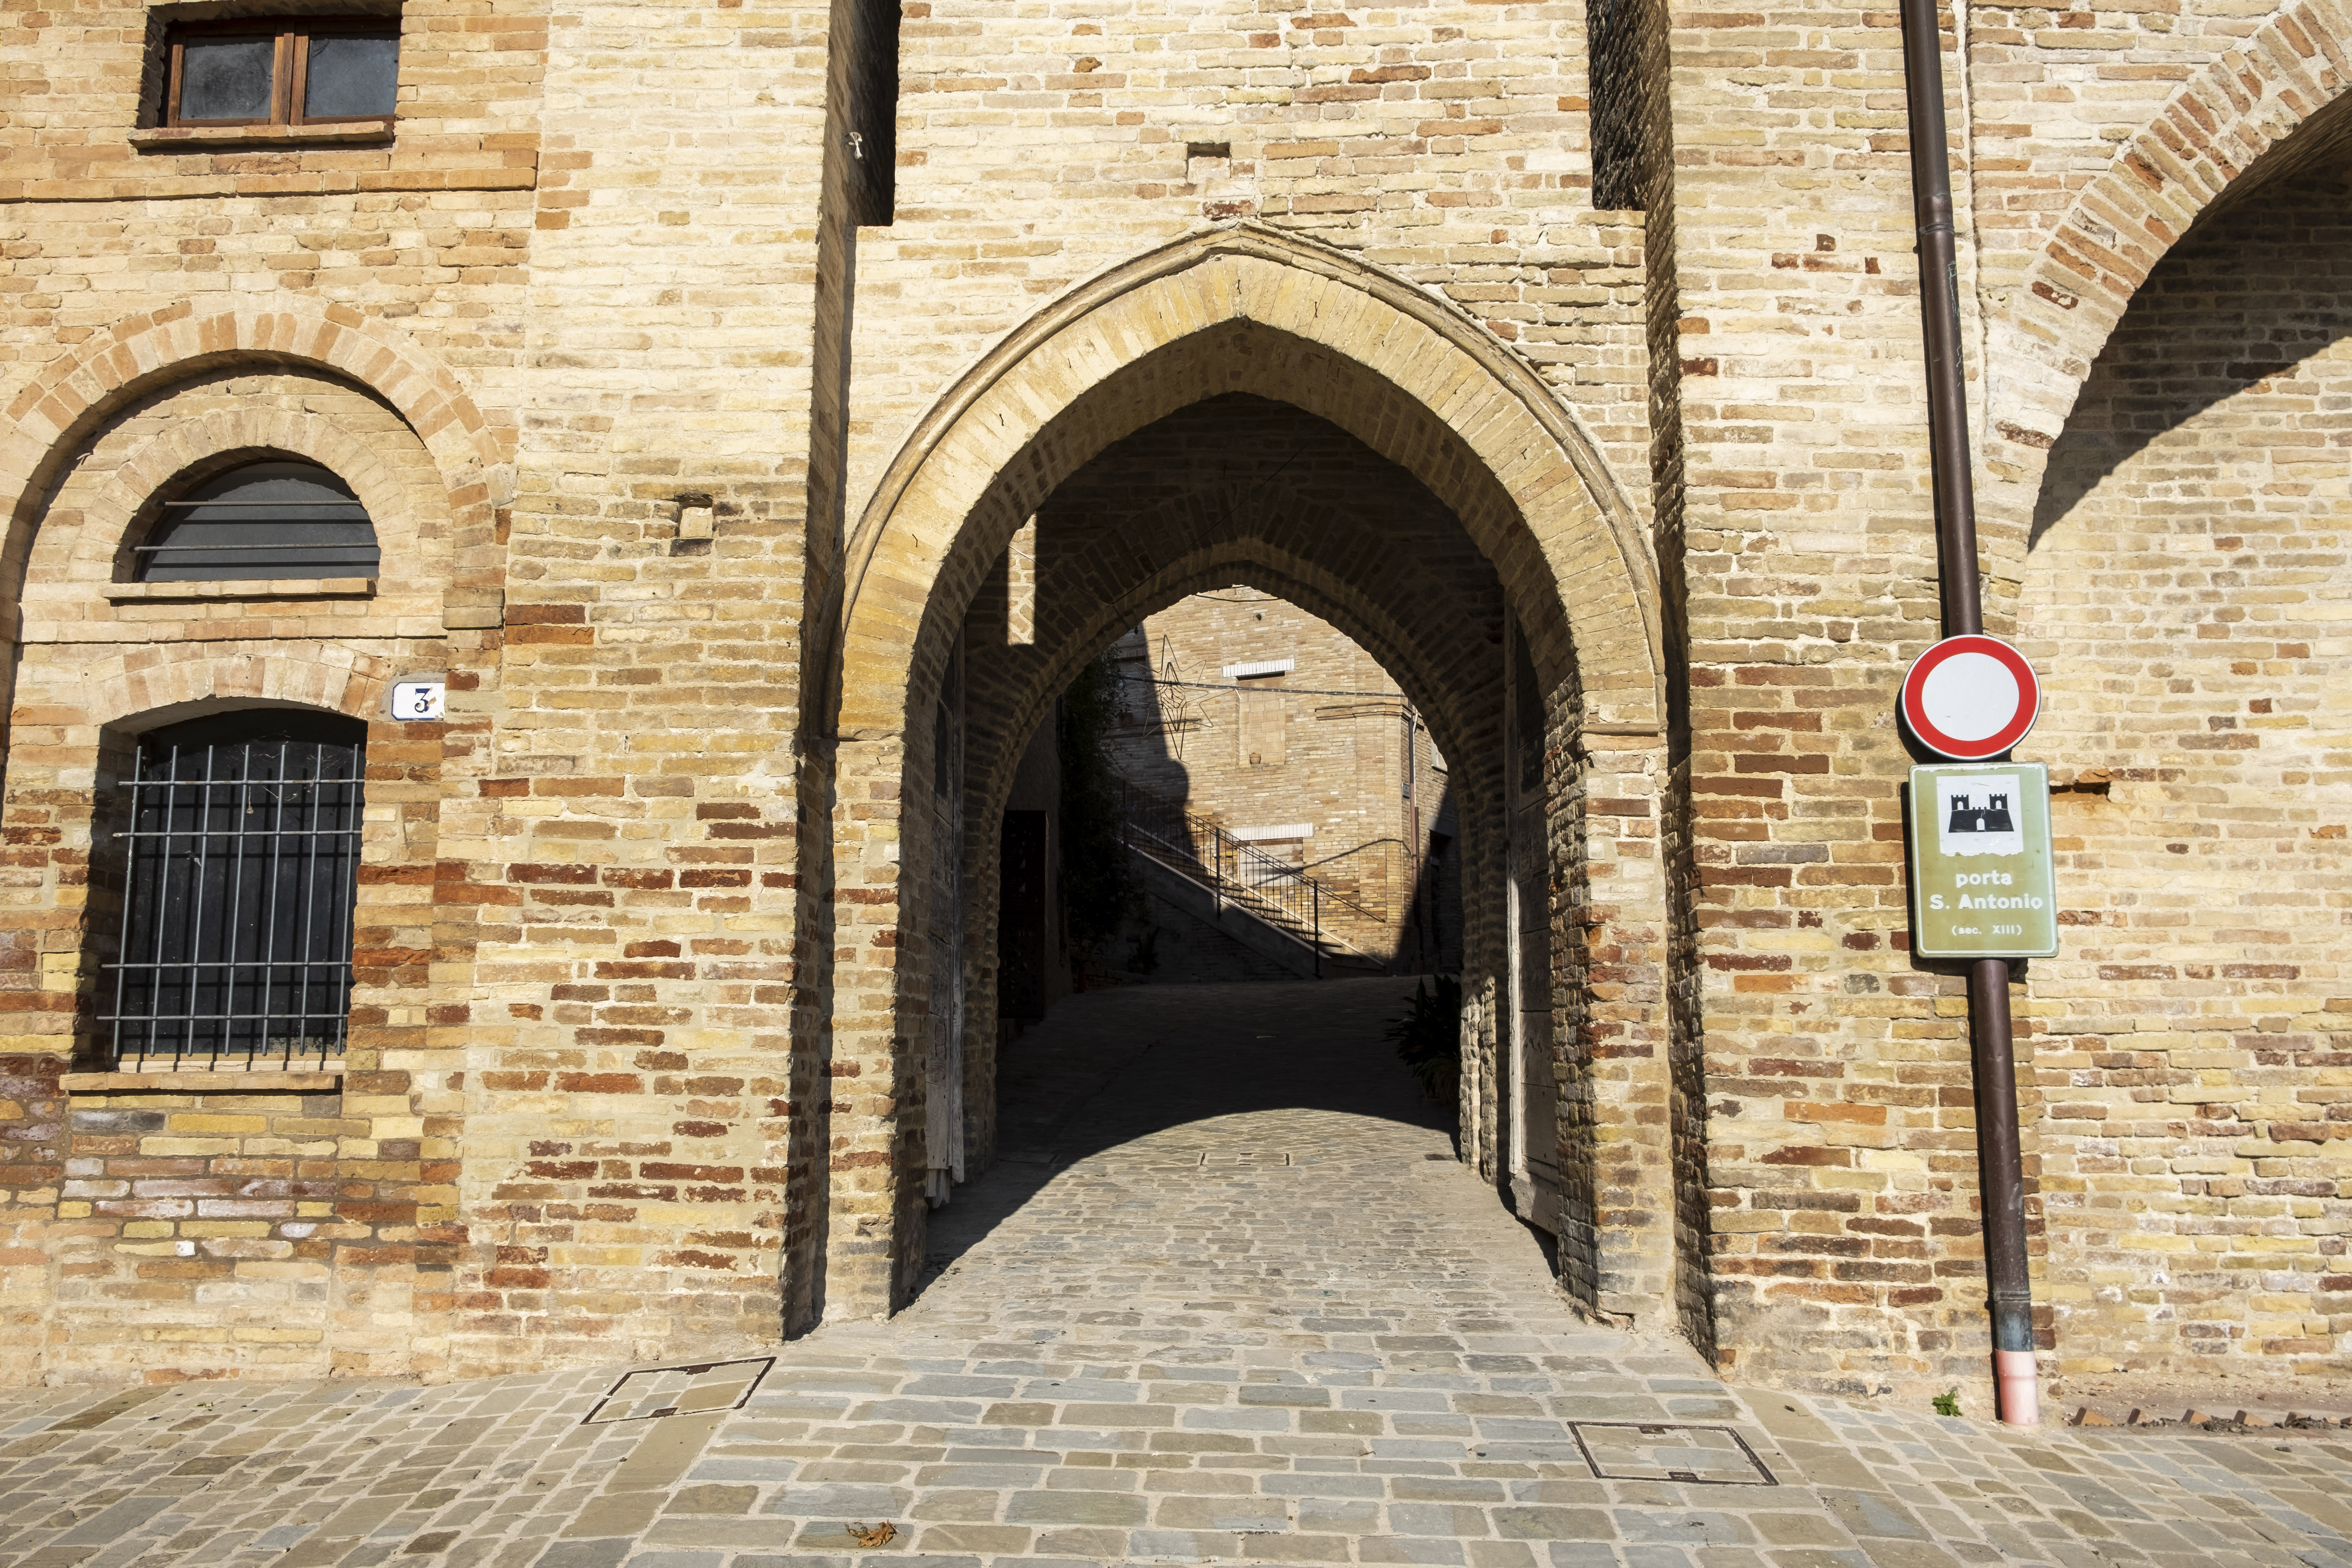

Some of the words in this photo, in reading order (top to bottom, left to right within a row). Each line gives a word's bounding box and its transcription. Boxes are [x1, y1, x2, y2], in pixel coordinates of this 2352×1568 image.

[415, 688, 430, 713] 3
[1956, 870, 2012, 888] porta
[1930, 894, 1950, 910] S.
[1959, 893, 2043, 909] Antonio
[1952, 925, 1982, 936] (sec.
[1993, 924, 2022, 936] XIII)
